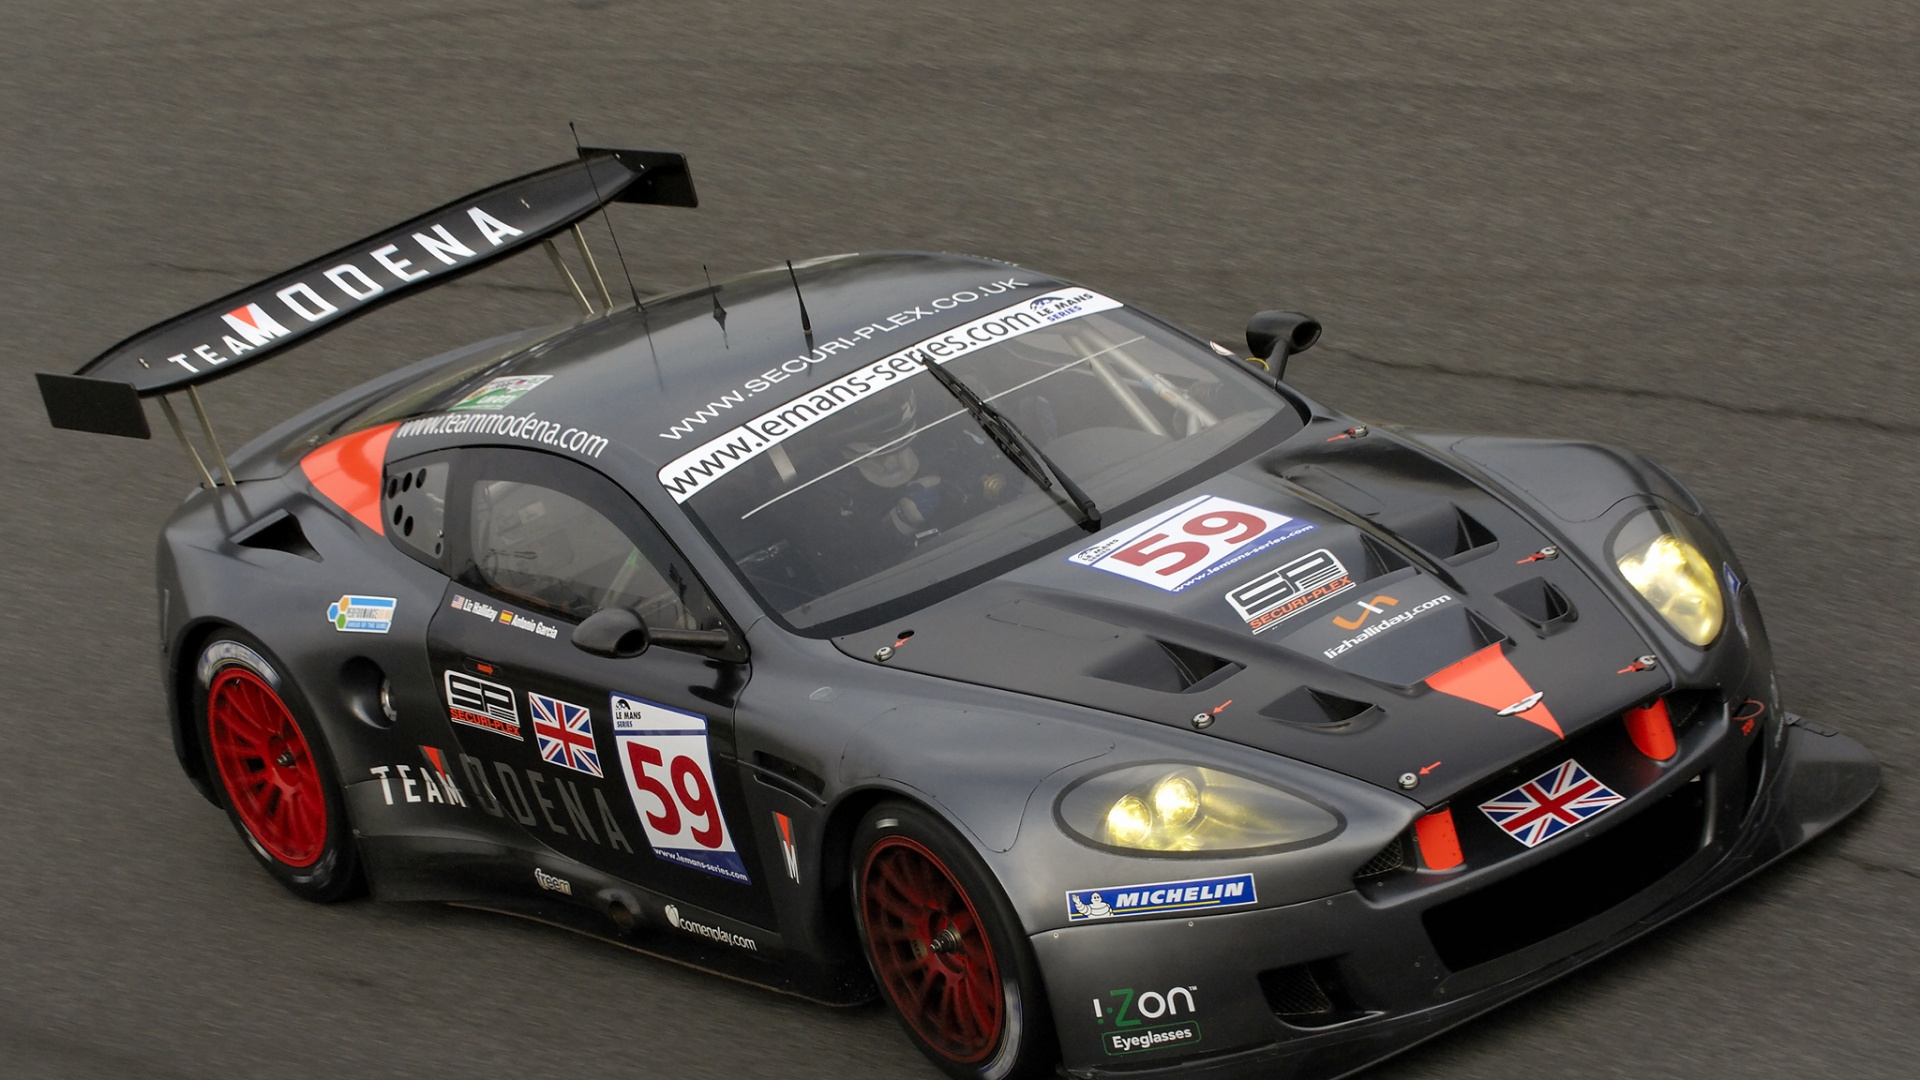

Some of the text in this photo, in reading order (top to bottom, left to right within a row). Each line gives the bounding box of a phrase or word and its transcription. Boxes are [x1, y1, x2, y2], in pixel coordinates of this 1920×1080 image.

[1037, 293, 1094, 317] LE MANS
[1047, 305, 1082, 322] SERIES
[659, 276, 1030, 441] WWW.SECURI-PLEX.CO.UK
[663, 311, 1041, 496] www.lemans-series.com
[396, 411, 609, 459] www.teammodena.com
[1110, 510, 1267, 576] 59
[1171, 524, 1314, 593] www.lemans-series.com
[463, 598, 474, 612] Liz
[1249, 575, 1352, 630] SECURI-PLEX
[1323, 592, 1452, 660] lizhalliday.com
[450, 707, 521, 736] SECURI-PLEX
[615, 711, 642, 720] LE MANS
[616, 720, 633, 728] SERIES
[626, 740, 723, 850] 59
[653, 848, 748, 881] www.lemans-series.com
[1116, 882, 1244, 908] MICHELIN
[680, 918, 757, 951] comenplay.com
[1112, 1028, 1193, 1051] Eyeglasses
